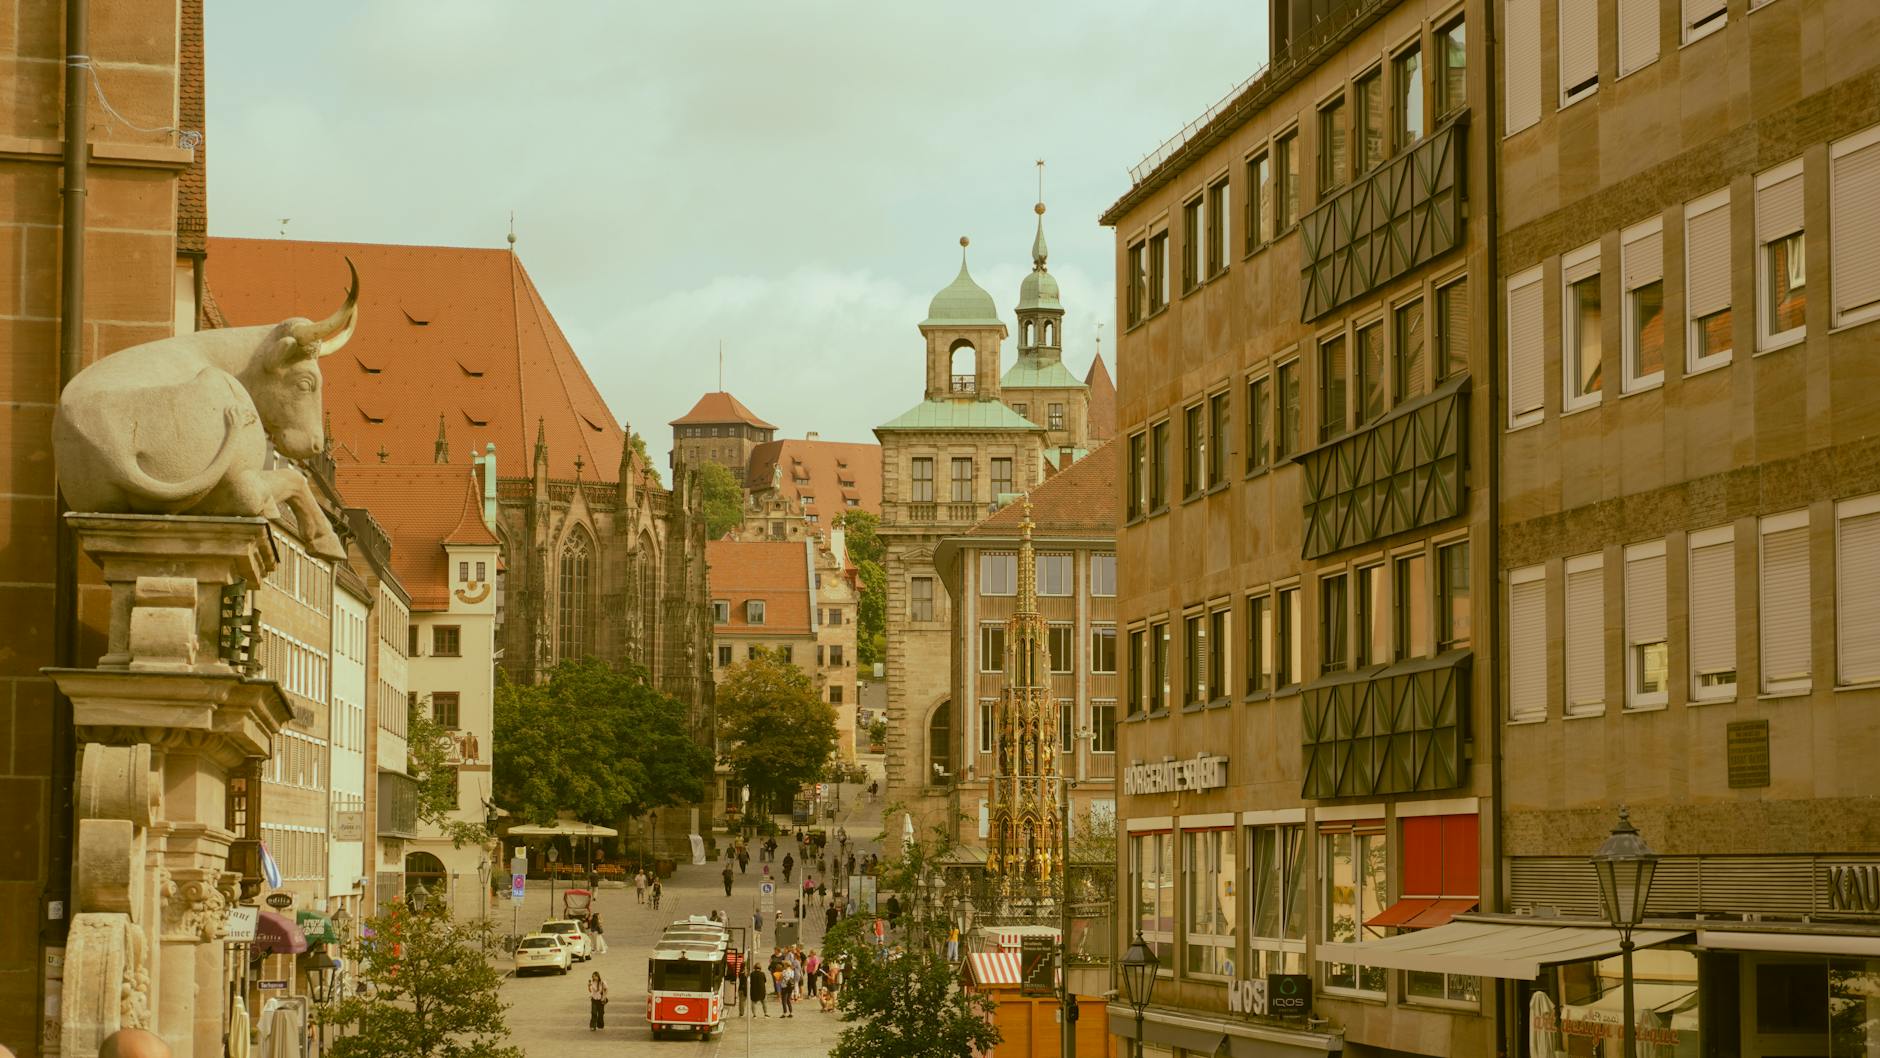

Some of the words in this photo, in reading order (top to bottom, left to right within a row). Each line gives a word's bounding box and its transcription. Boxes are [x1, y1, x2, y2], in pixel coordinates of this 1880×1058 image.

[1827, 868, 1880, 911] KAU
[1273, 998, 1304, 1007] IQOS
[1617, 1014, 1681, 1046] atique
